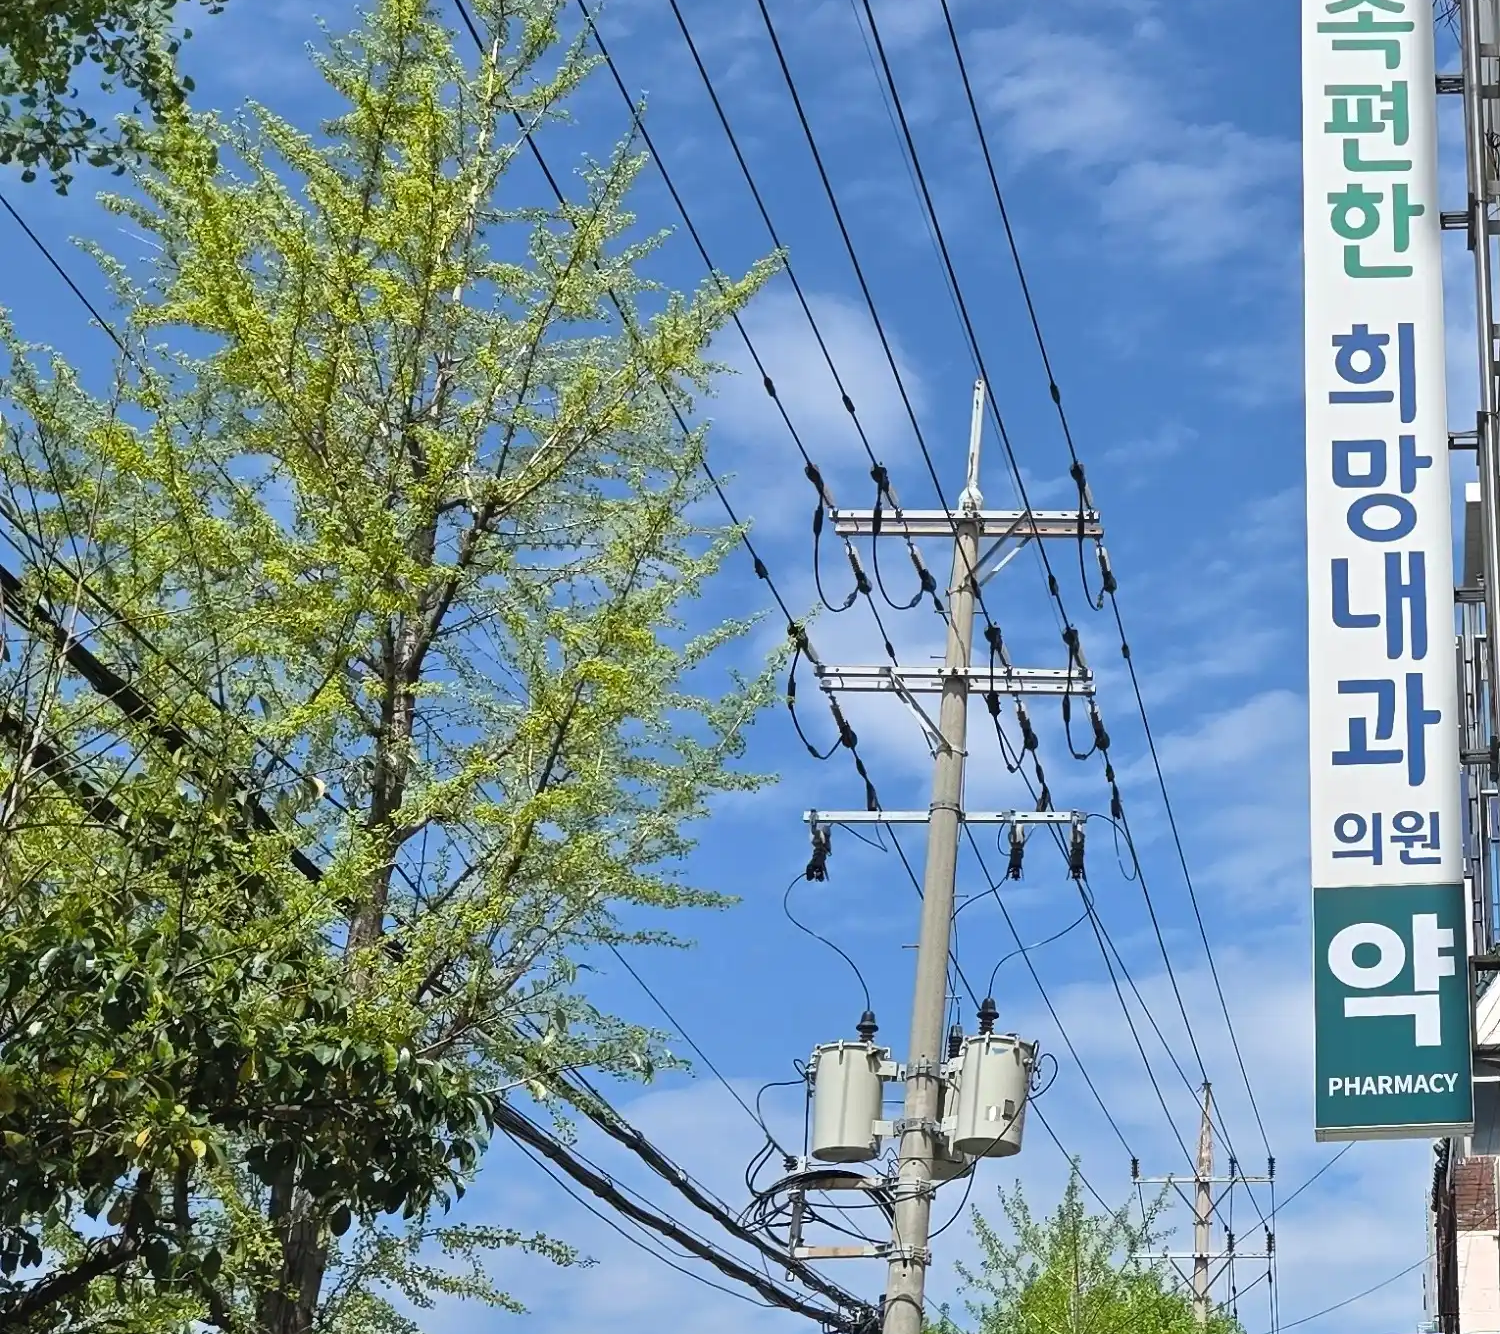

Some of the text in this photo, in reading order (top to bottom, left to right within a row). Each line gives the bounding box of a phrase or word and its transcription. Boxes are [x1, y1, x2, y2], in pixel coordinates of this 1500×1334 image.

[1329, 323, 1442, 787] 희망내과
[1331, 810, 1442, 866] 의원
[1327, 912, 1456, 1048] 약
[1327, 1072, 1459, 1097] PHARMACY
